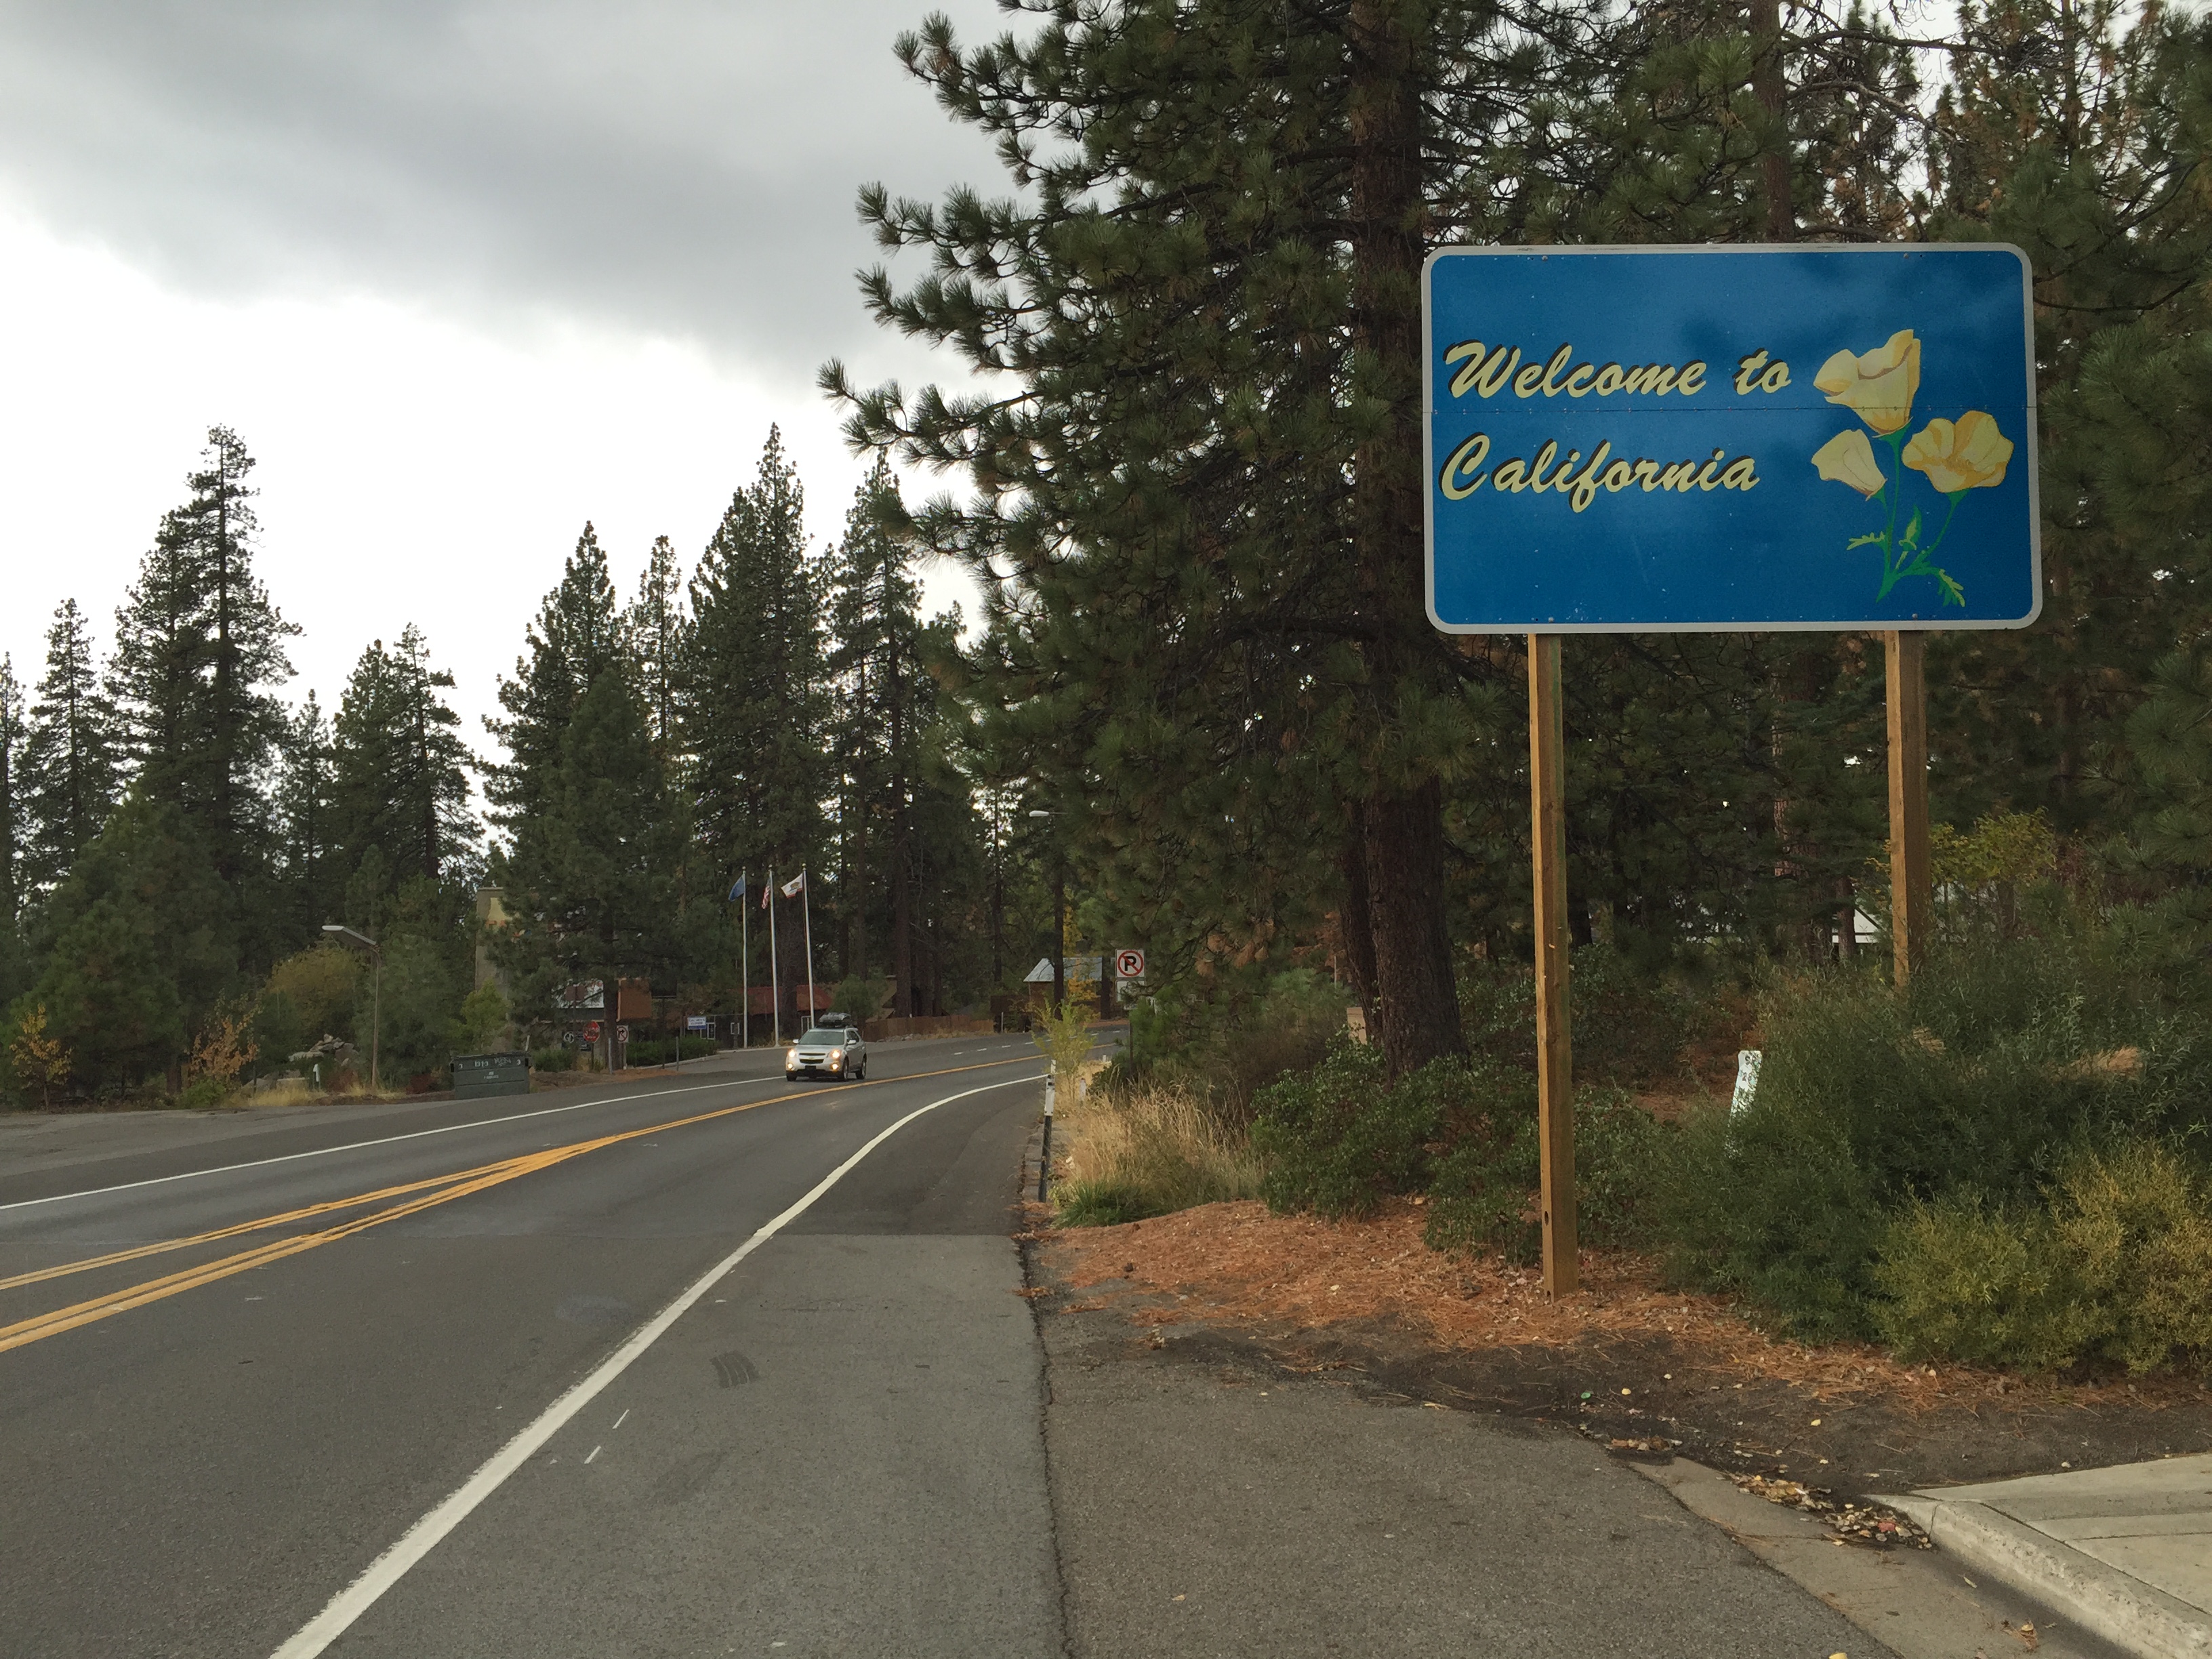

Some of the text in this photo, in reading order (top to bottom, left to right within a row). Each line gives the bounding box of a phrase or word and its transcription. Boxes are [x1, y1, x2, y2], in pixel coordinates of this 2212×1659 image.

[1443, 340, 1791, 398] Welcome to
[1438, 432, 1761, 513] California
[1125, 956, 1136, 971] P
